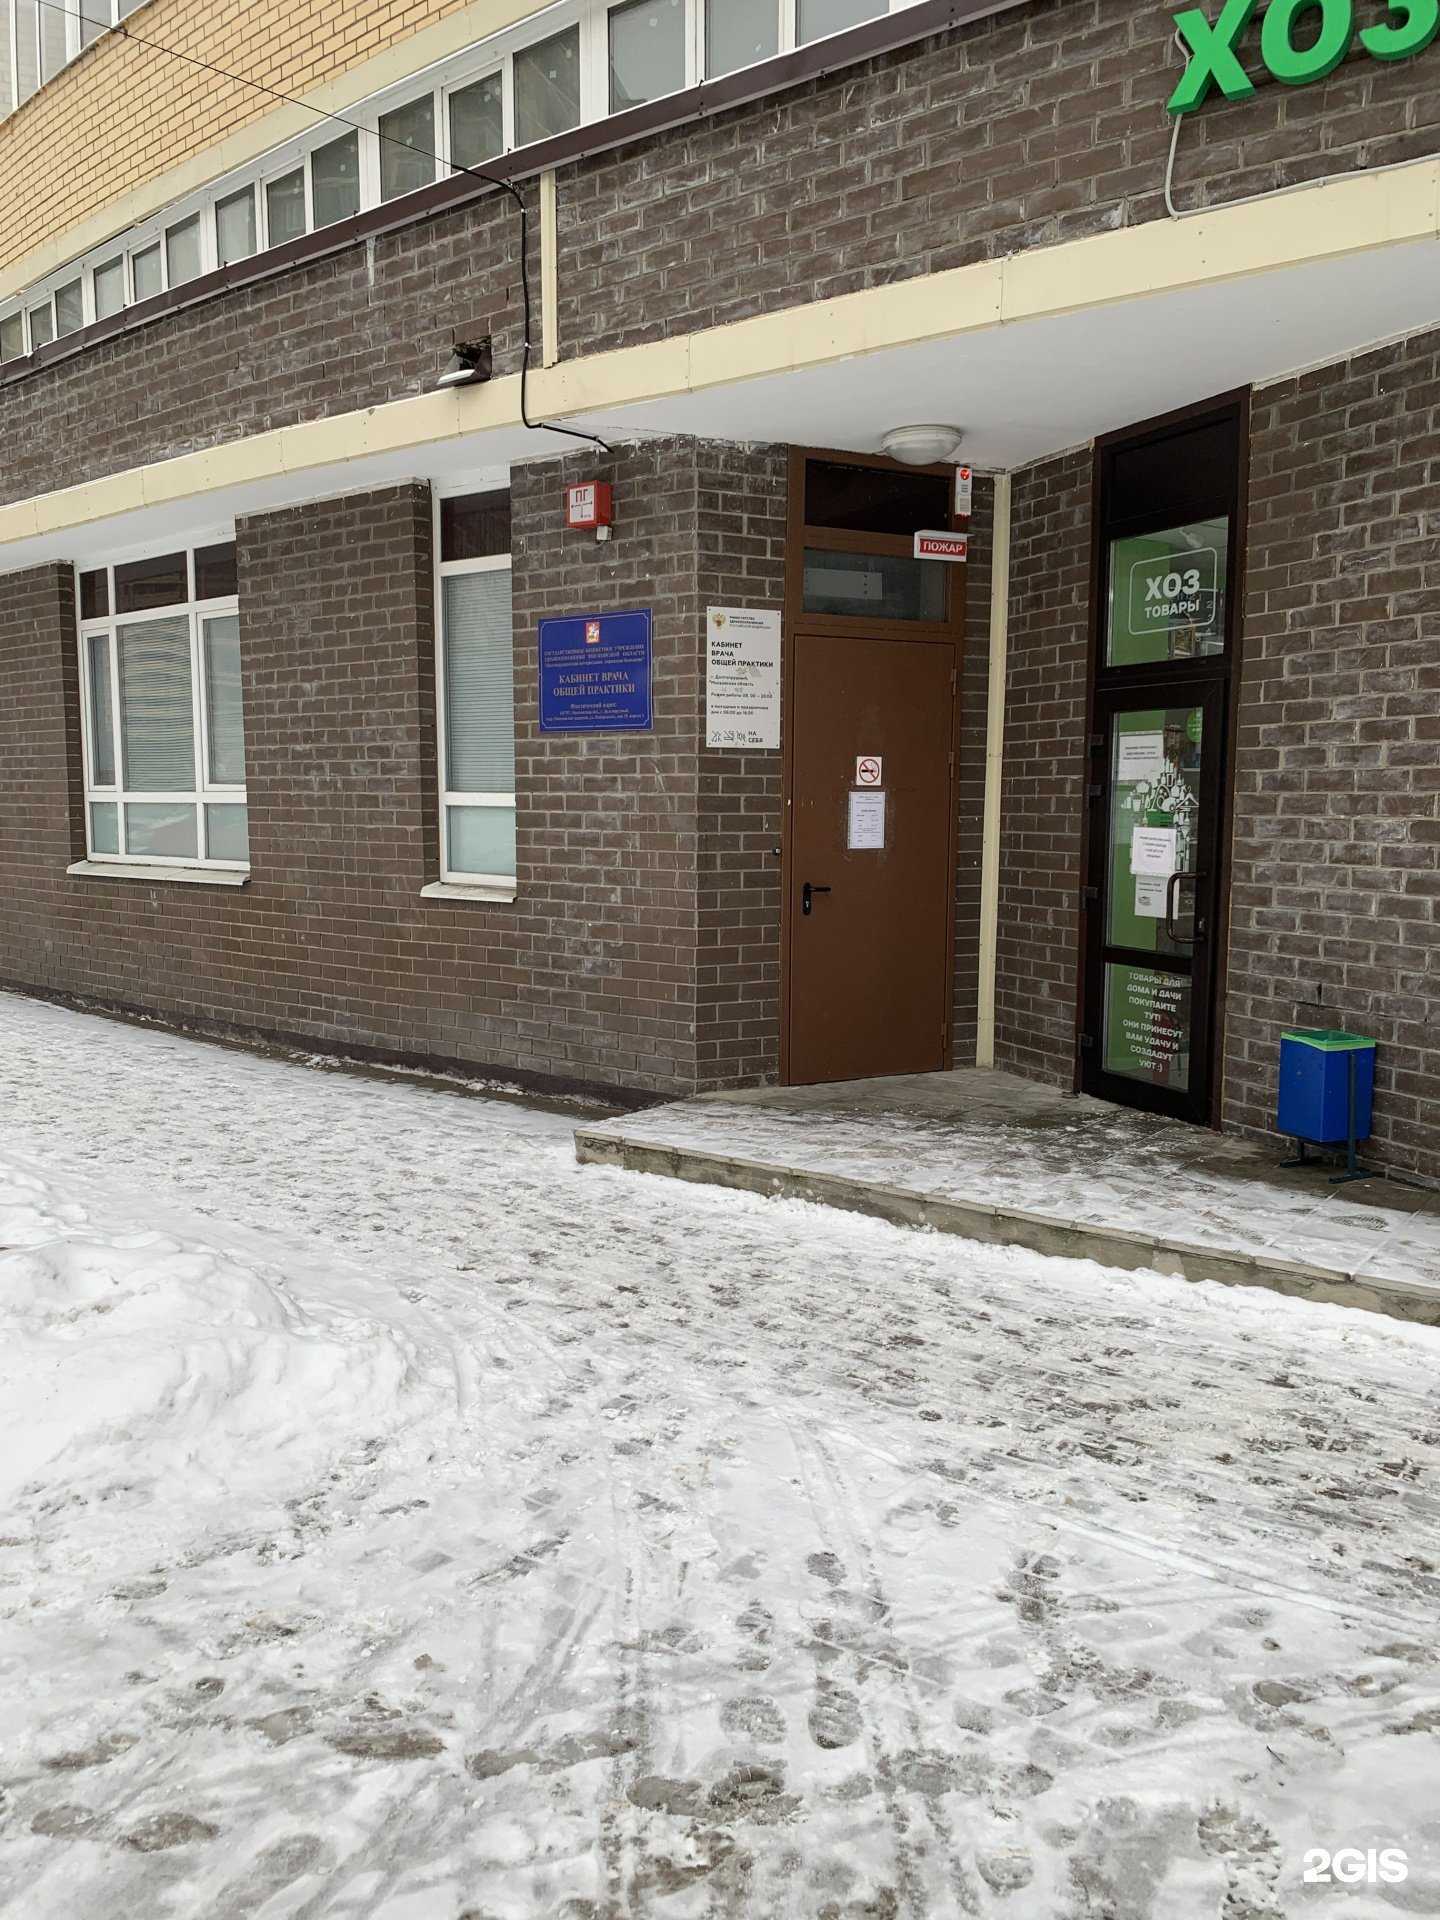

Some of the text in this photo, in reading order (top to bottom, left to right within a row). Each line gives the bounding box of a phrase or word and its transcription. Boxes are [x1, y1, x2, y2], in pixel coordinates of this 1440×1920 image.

[575, 488, 588, 503] ПГ
[923, 540, 963, 553] ПОЖАР
[1144, 568, 1200, 601] ХОЗ
[1144, 599, 1200, 619] ТОВАРЫ
[559, 672, 628, 684] КАБИНЕТ ВРАЧА
[553, 683, 635, 697] ОБЩЕЙ ПРАКТИКИ
[1129, 972, 1162, 985] ТОВАРЫ
[1127, 983, 1182, 1001] ДОМА И ДАЧИ
[1122, 1019, 1184, 1039] ОНИ ПРИНЕСУТ
[1125, 1031, 1179, 1051] ВАМ УДАЧУ И
[1130, 1044, 1173, 1062] СОЗДАДУТ
[1138, 1058, 1157, 1070] УЮТ
